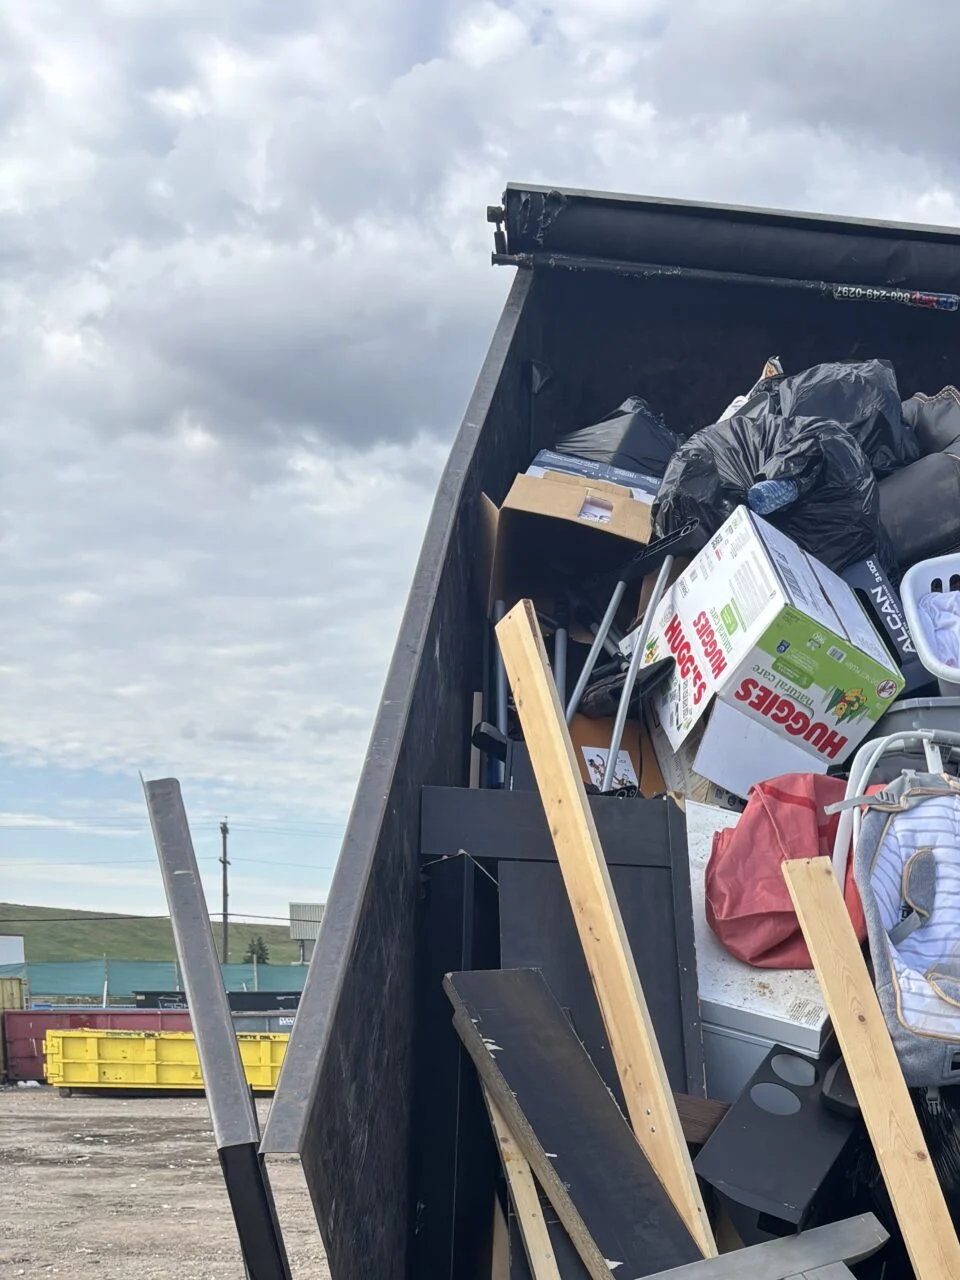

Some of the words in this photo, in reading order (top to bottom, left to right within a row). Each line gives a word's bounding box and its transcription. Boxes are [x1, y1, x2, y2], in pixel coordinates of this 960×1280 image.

[835, 285, 911, 303] 800-249-0297
[871, 585, 916, 653] ALCAN
[692, 610, 728, 680] HUGGIES
[752, 664, 777, 683] care
[777, 678, 814, 707] natural
[734, 678, 848, 760] HUGGIES
